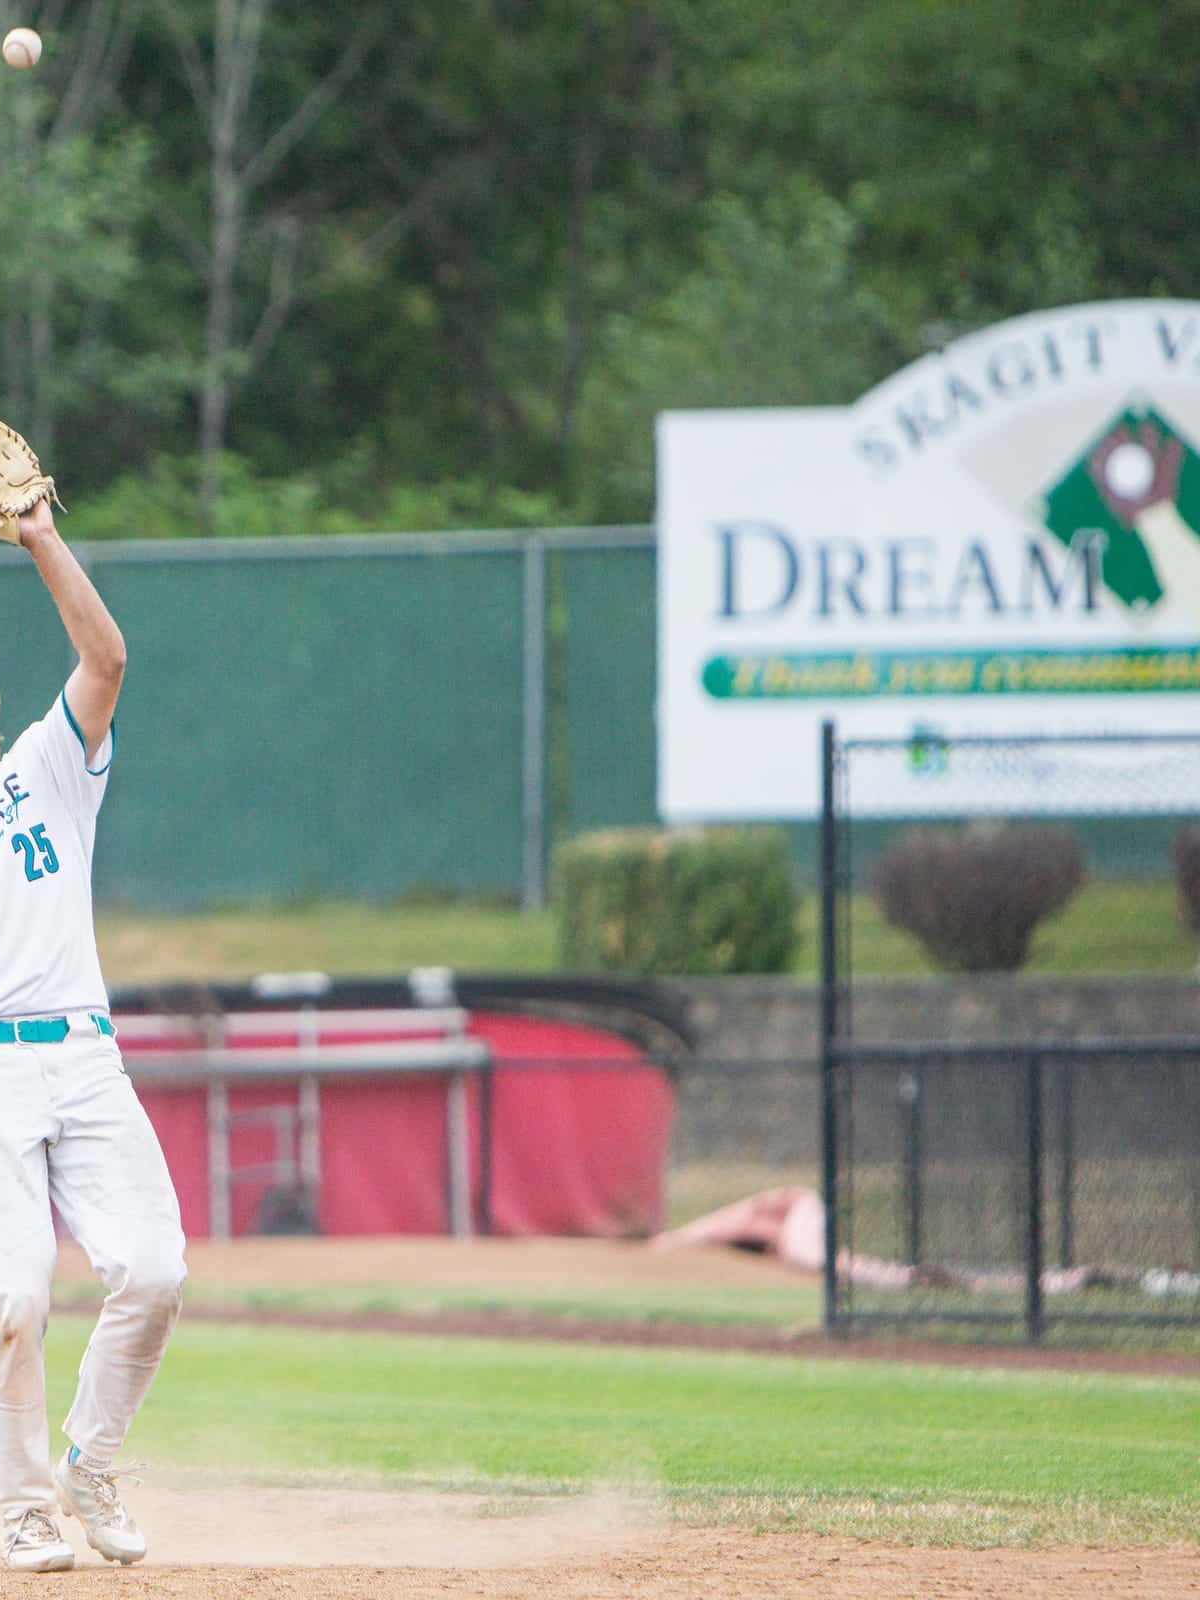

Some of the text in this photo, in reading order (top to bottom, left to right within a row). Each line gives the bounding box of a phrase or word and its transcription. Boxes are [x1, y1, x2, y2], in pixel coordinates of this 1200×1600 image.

[853, 317, 1119, 464] SKAGIT
[713, 521, 1106, 620] DREAM
[11, 823, 59, 881] 25
